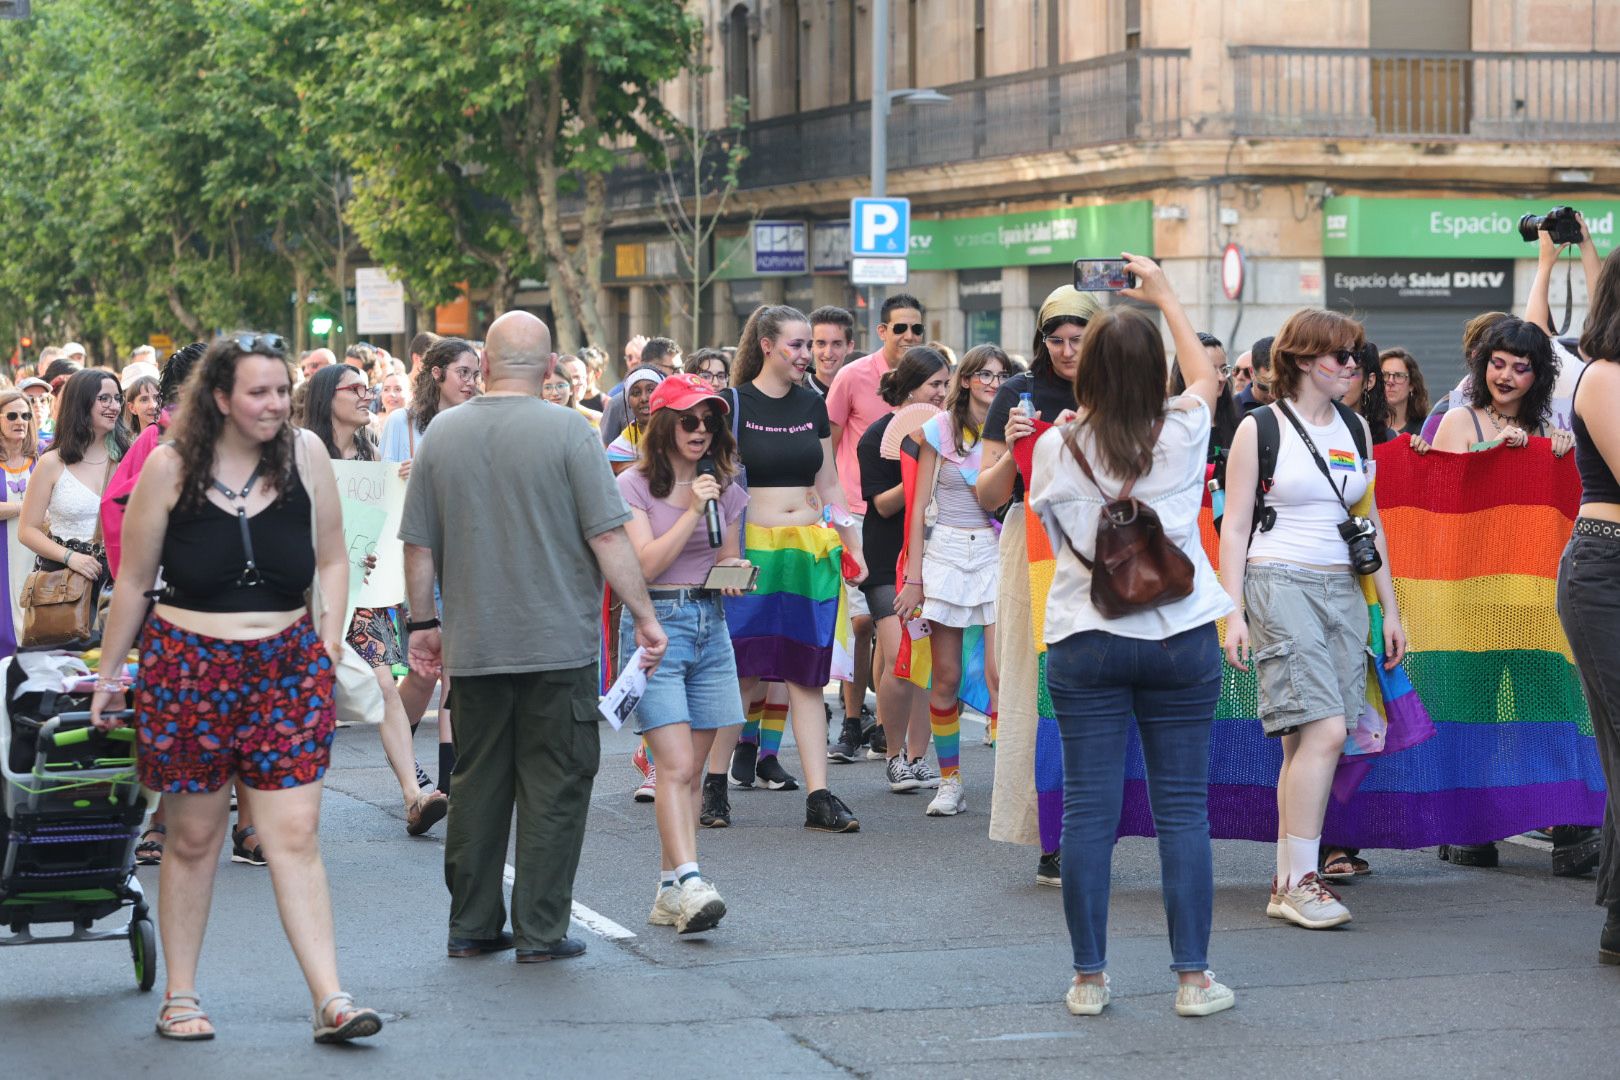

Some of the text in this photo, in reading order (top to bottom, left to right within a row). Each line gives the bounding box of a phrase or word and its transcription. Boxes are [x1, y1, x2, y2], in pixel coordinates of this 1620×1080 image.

[861, 203, 900, 250] P
[1430, 211, 1512, 239] Espacio
[1334, 271, 1505, 292] Espacio de Salud DKV
[745, 420, 764, 431] kiss
